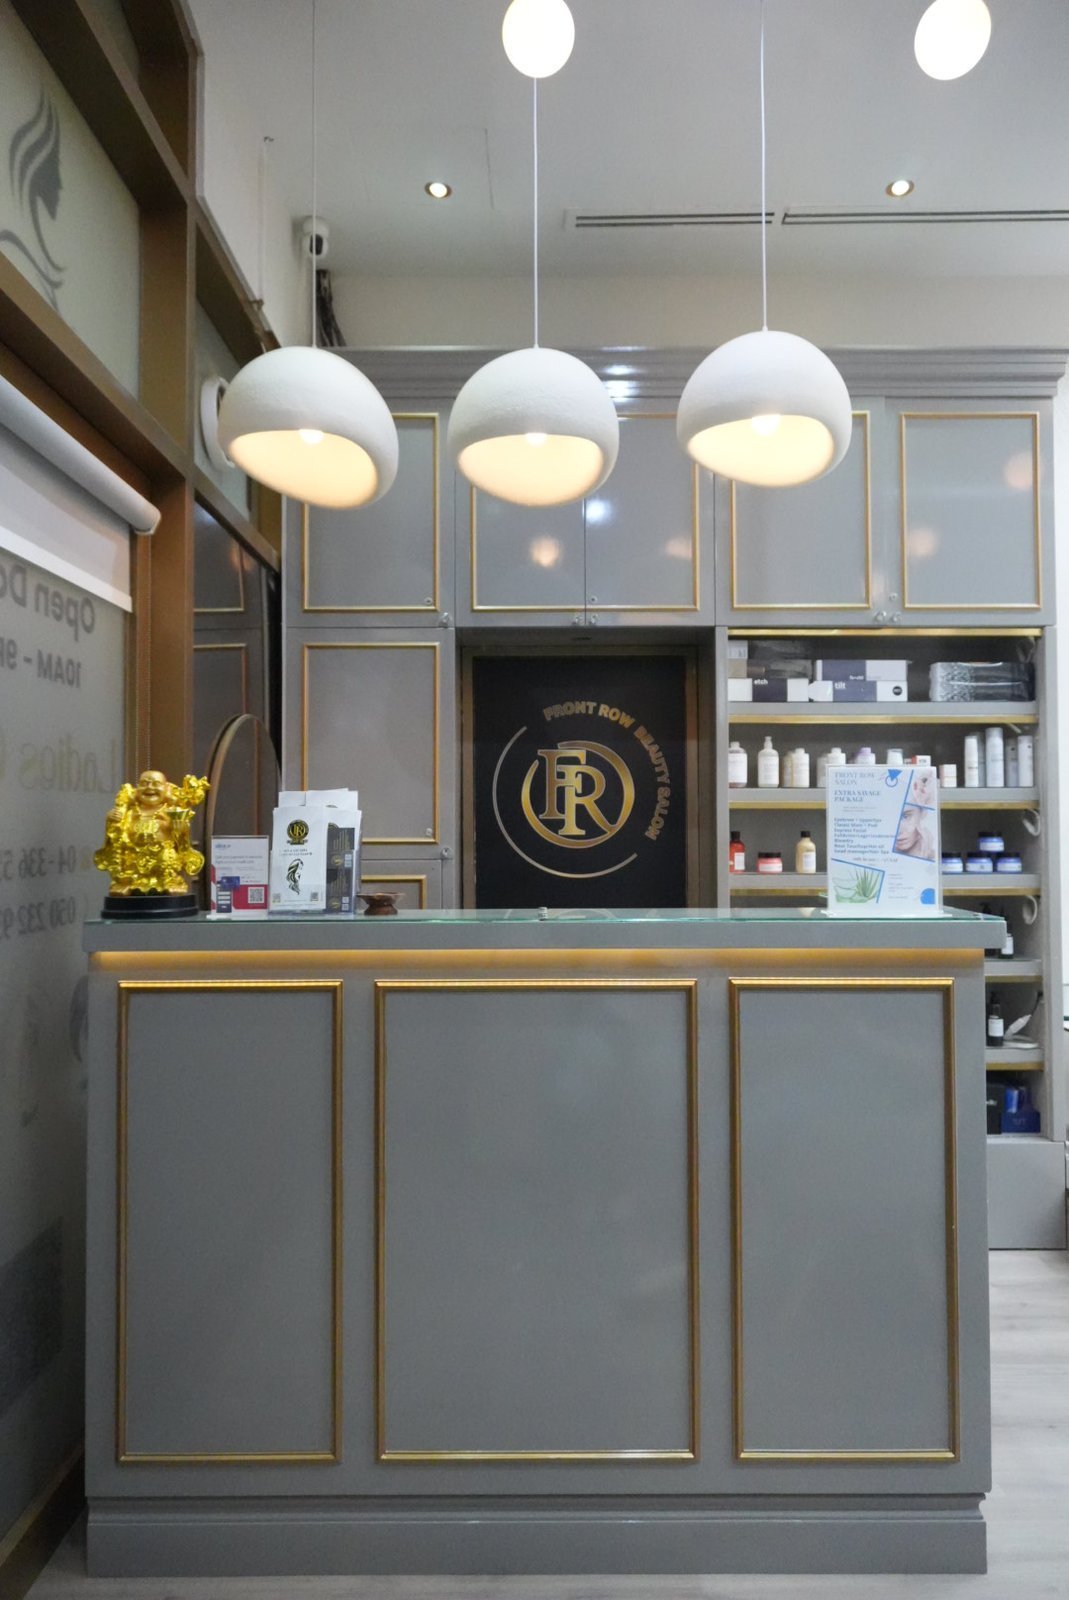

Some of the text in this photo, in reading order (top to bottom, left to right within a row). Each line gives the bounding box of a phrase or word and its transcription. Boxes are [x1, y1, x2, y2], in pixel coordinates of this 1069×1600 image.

[834, 681, 846, 690] tilt
[543, 700, 672, 841] FRONT ROW BEAUTY SALON
